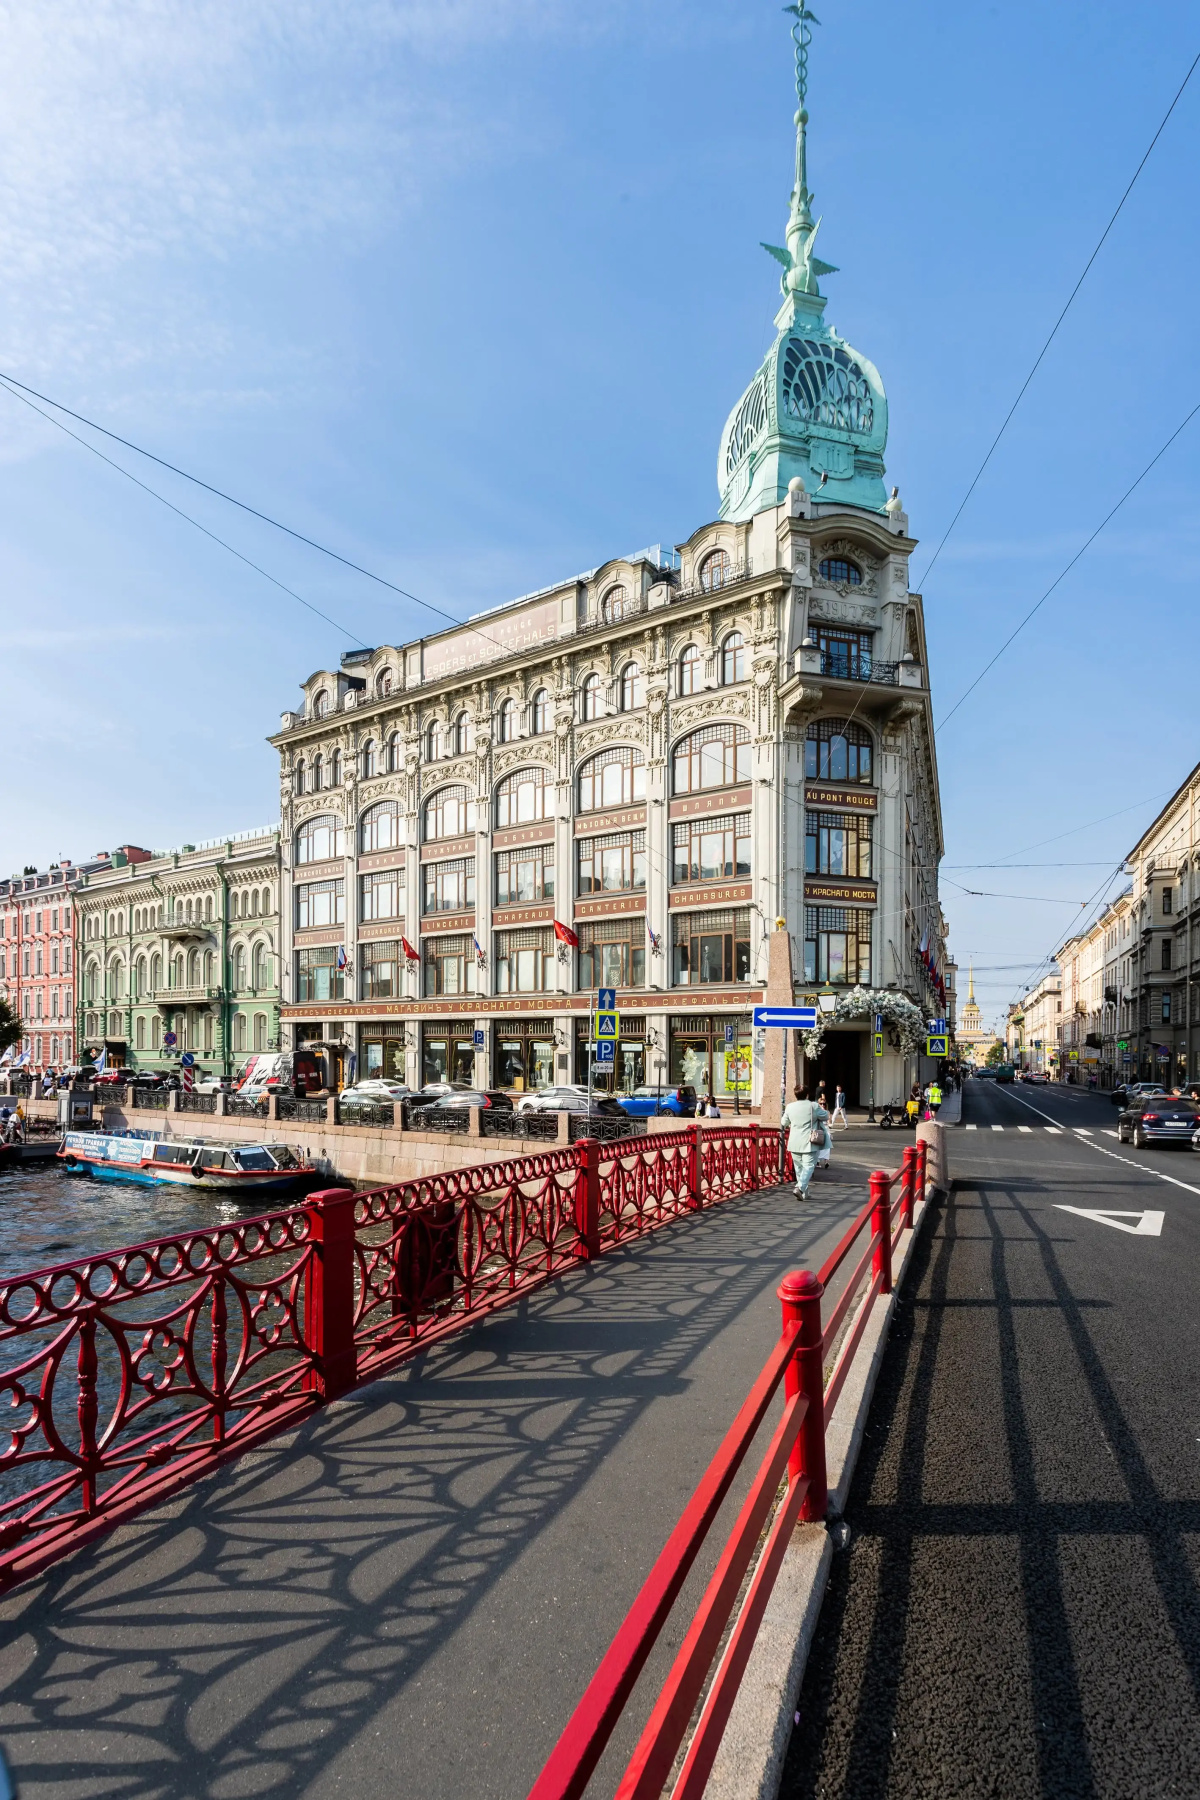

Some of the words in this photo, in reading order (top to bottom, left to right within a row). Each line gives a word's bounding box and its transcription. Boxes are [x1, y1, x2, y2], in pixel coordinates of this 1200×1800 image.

[426, 655, 466, 677] ESDERS
[468, 653, 477, 663] ET
[480, 625, 555, 658] SCHEEFHALS
[682, 795, 738, 812] ШЛЯПЫ
[806, 792, 818, 800] AU
[820, 793, 843, 802] PONT
[846, 795, 875, 806] ROUGE
[621, 812, 645, 823] ВЕЩИ
[504, 830, 543, 843] ОБУВЬ
[427, 843, 469, 856] ТУЖУРКИ
[675, 889, 746, 904] CHAUSSURES
[805, 887, 810, 895] У
[812, 888, 850, 898] КРАСНАГО
[852, 890, 876, 899] МОСТА
[498, 911, 549, 922] CHAPEAUX
[386, 1003, 442, 1014] МАГАЗИНЪ
[448, 1004, 454, 1012] У
[459, 1001, 520, 1012] КРАСНАГО
[527, 999, 572, 1010] МОСТА
[601, 1042, 611, 1059] P
